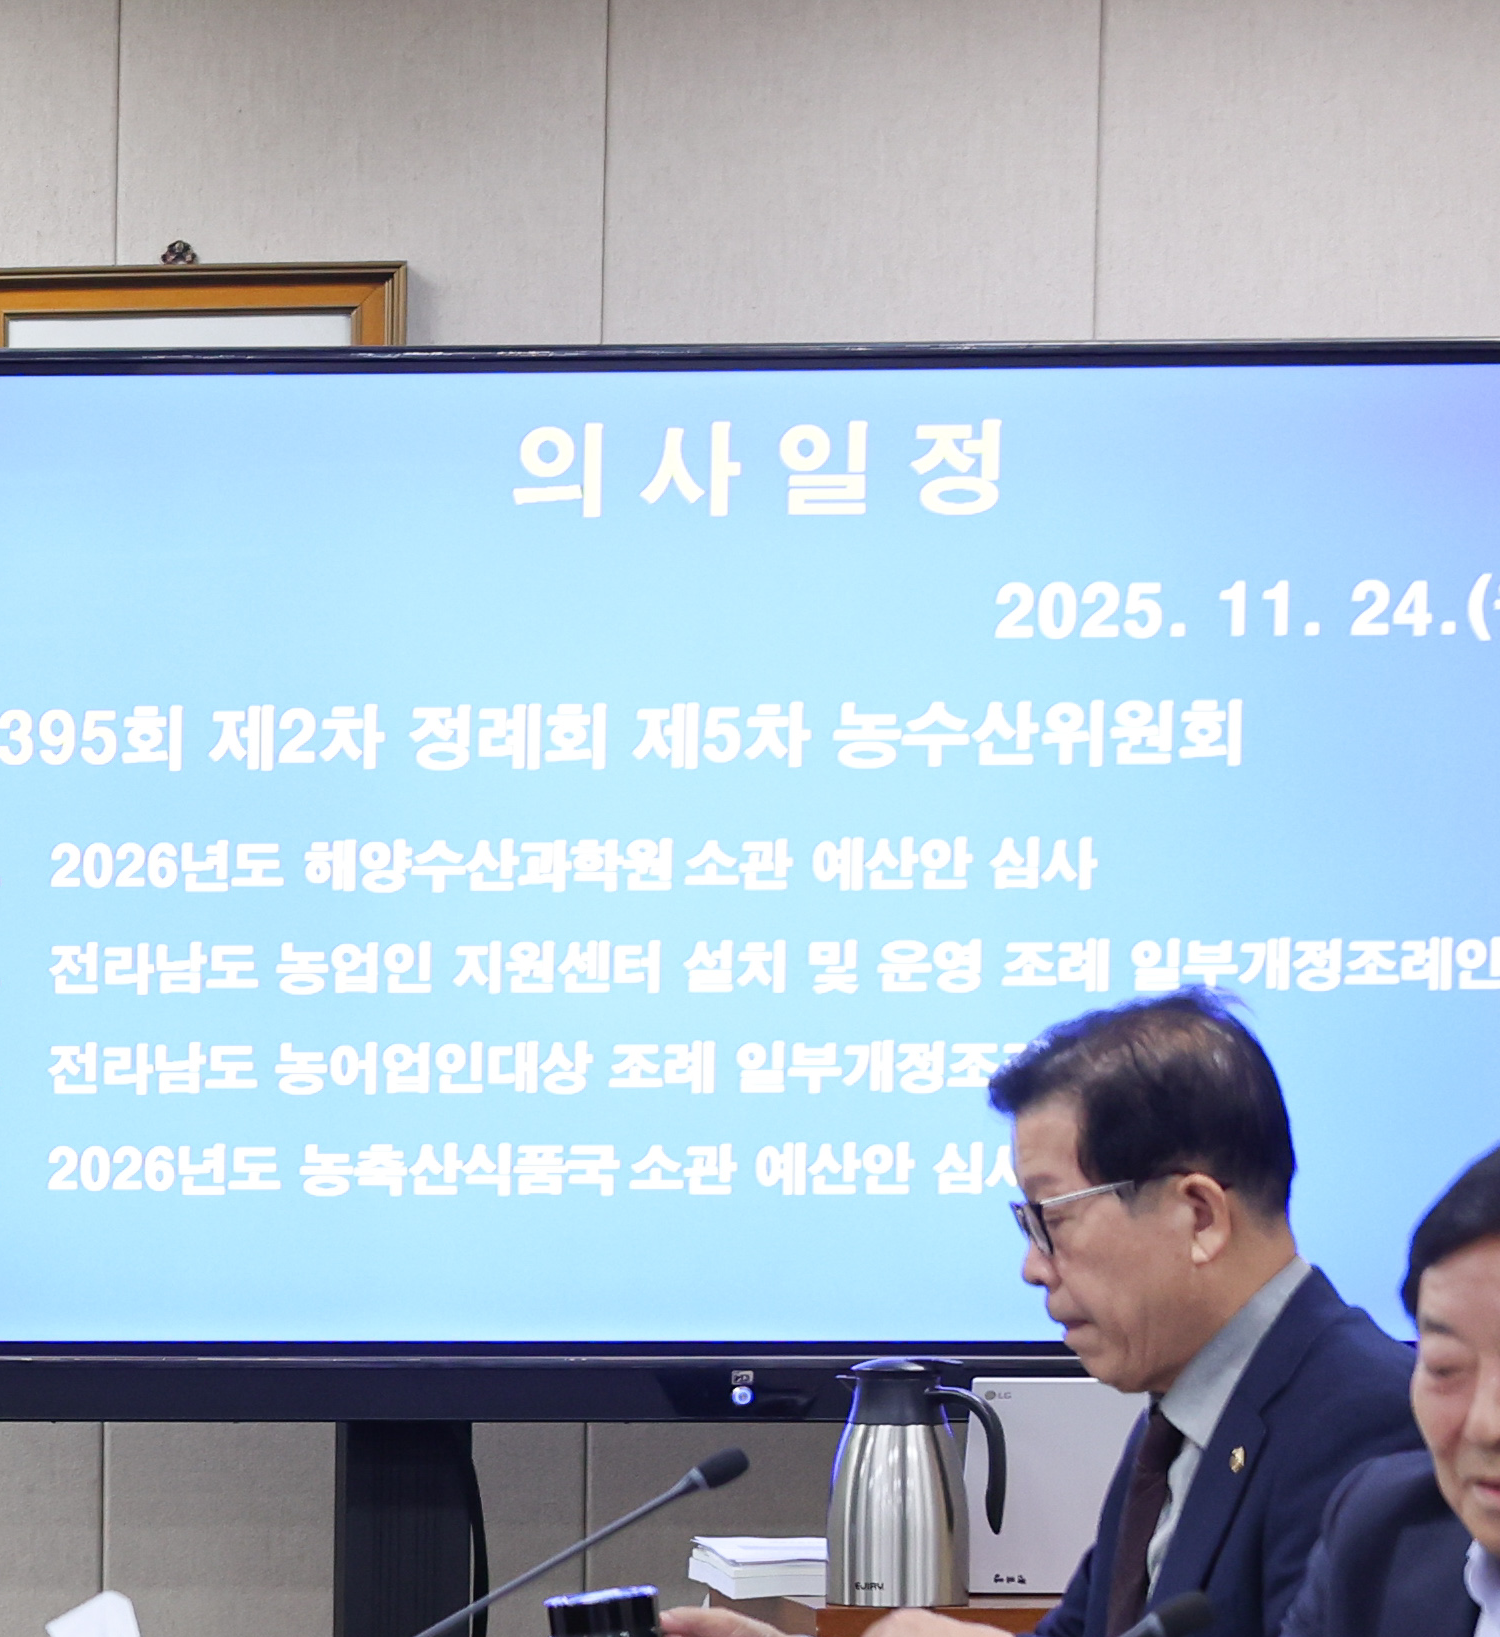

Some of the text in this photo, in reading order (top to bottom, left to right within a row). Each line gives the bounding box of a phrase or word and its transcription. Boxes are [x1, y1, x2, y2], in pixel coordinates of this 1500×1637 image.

[995, 581, 1186, 640] 2025.
[1219, 580, 1320, 637] 11.
[208, 703, 386, 772] 제2차
[409, 702, 607, 771] 정례회
[632, 700, 812, 770] 제5차
[833, 698, 1243, 769] 농수산위원회
[50, 839, 285, 892] 2026년도
[304, 838, 674, 894] 해양수산과학원
[683, 837, 794, 893] 소관
[812, 836, 974, 892] 예산안
[989, 836, 1099, 891] 심사
[48, 941, 259, 996] 전라남도
[275, 940, 432, 996] 농업인
[453, 939, 662, 995] 지원센터
[683, 939, 787, 994] 설치
[808, 939, 859, 995] 및
[877, 938, 983, 994] 운영
[1001, 937, 1111, 992] 조례
[47, 1041, 258, 1096] 전라남도
[274, 1040, 594, 1096] 농어업인대상
[608, 1039, 716, 1094] 조례
[736, 1039, 1027, 1094] 일부개정조
[47, 1142, 281, 1196] 2026년도
[299, 1142, 617, 1197] 농축산식품국
[628, 1141, 738, 1196] 소관
[755, 1141, 916, 1196] 예산안
